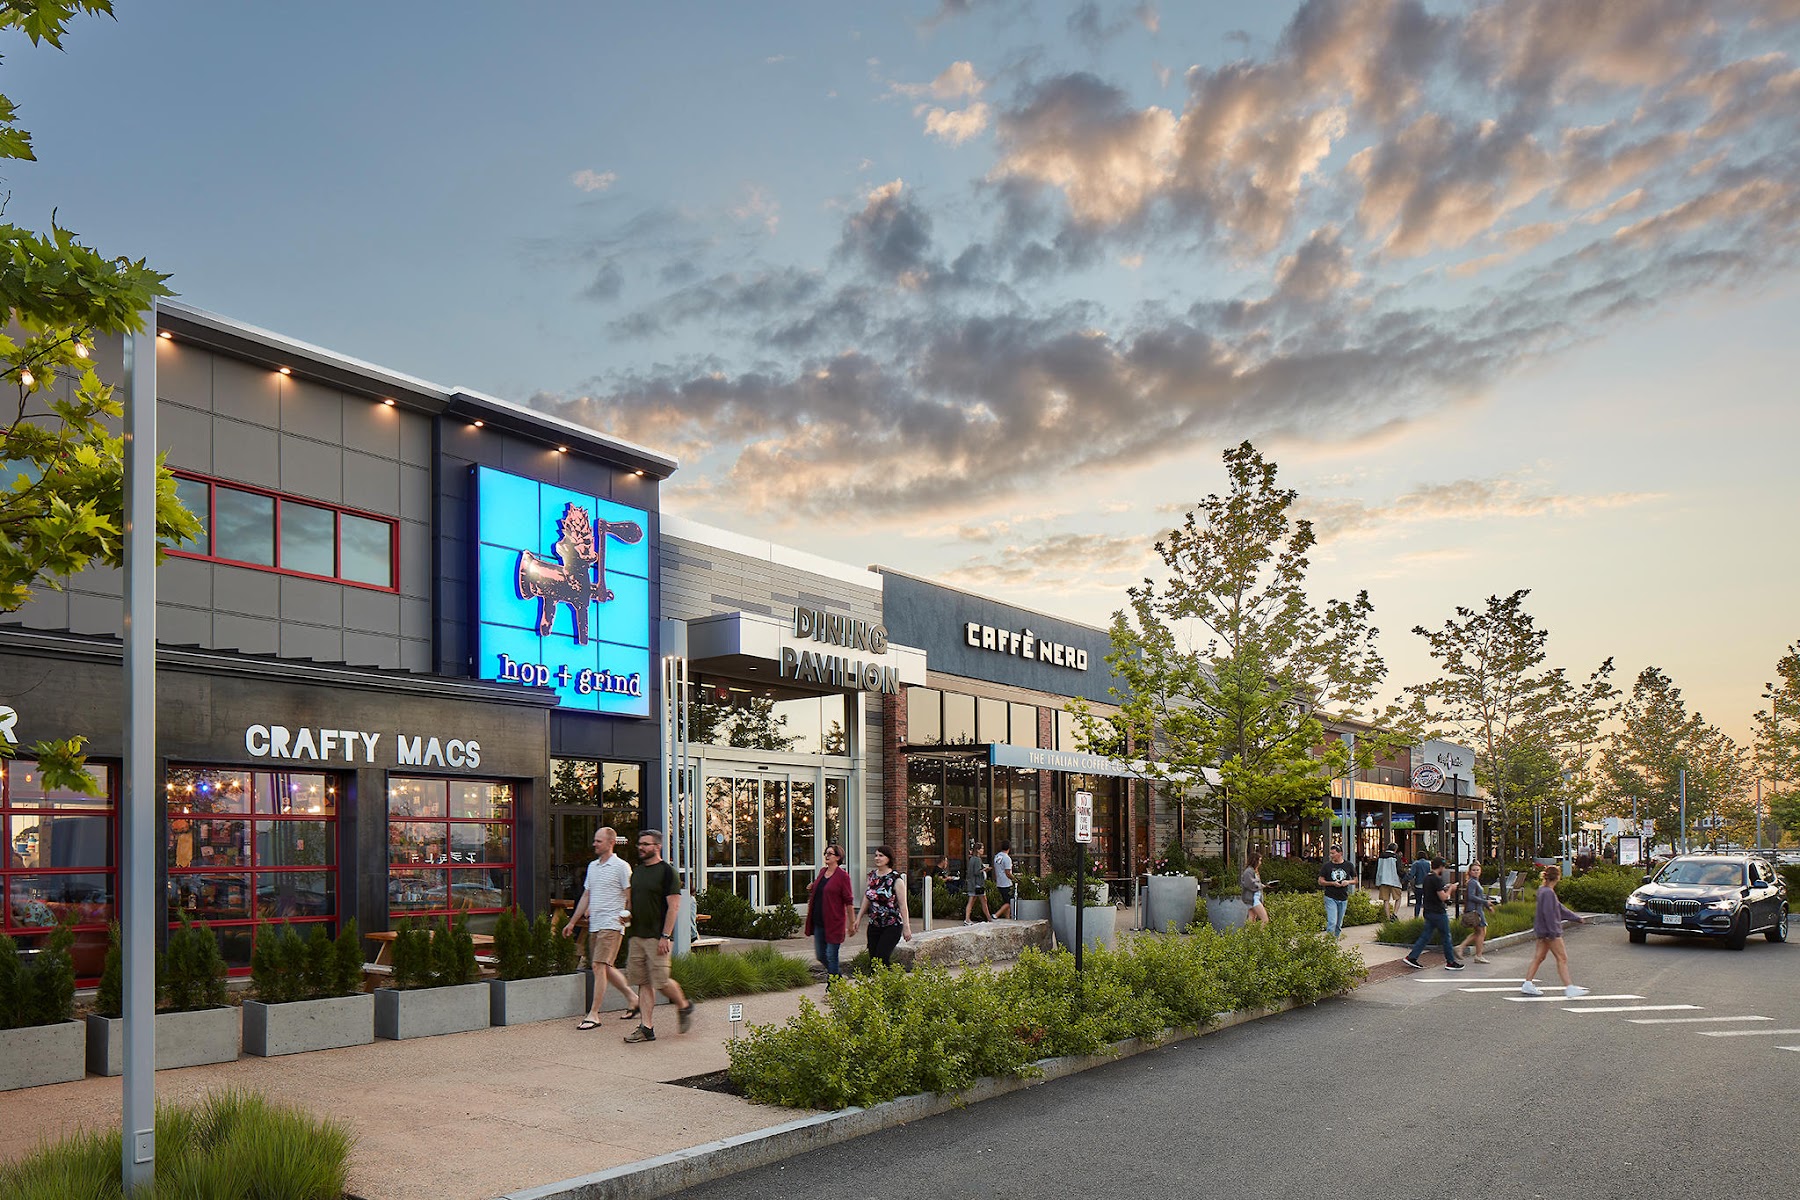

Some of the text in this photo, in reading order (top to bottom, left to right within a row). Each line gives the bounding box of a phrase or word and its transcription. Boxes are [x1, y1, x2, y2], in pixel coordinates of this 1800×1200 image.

[794, 606, 888, 655] DINING
[965, 622, 1088, 671] CAFFÈ NERO
[499, 653, 642, 697] hop + grind
[779, 646, 900, 695] PAVILION
[245, 724, 481, 769] CRAFTY MACS
[1029, 752, 1044, 765] THE
[1047, 754, 1079, 769] ITALIAN
[1081, 758, 1109, 772] COFFEE
[1077, 806, 1091, 816] PARKING
[1080, 796, 1088, 806] NO
